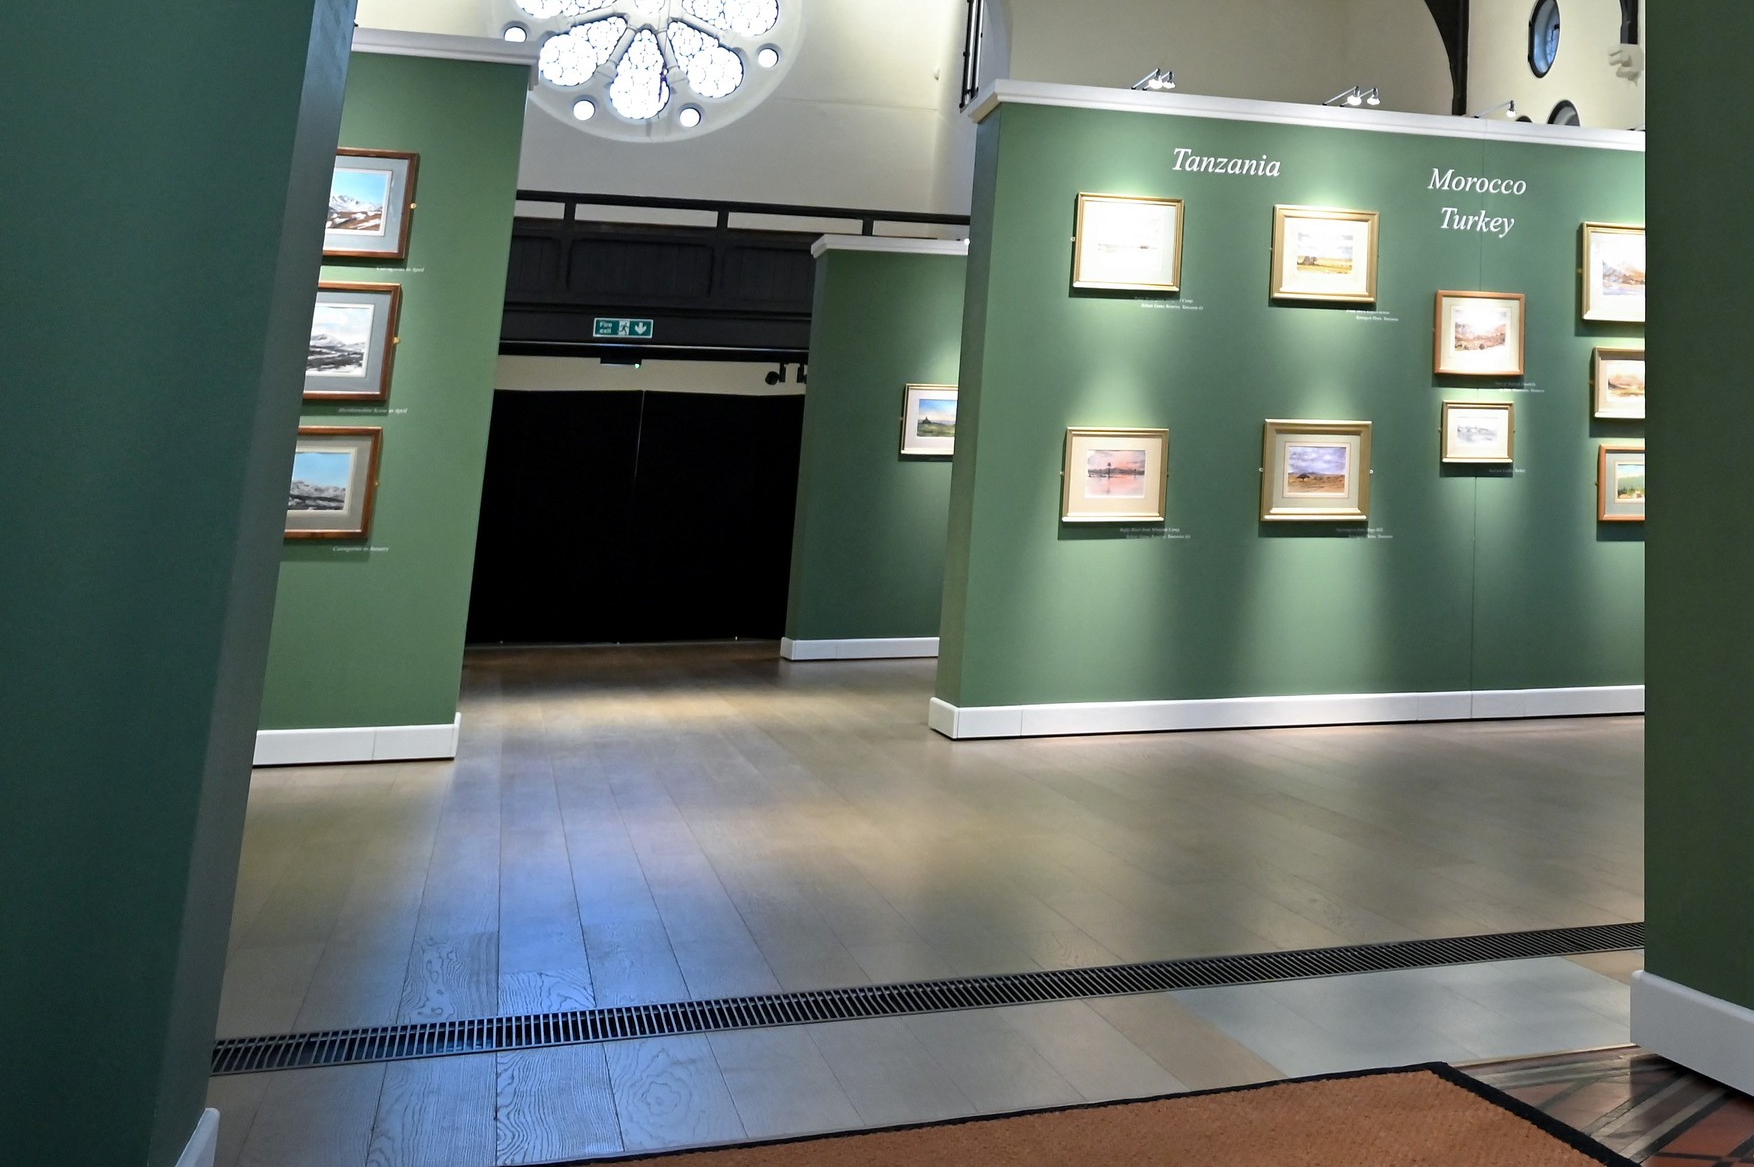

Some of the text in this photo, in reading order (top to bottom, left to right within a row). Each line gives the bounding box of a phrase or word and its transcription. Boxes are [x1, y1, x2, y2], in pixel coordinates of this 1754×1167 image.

[1172, 148, 1281, 177] Tanzania
[1427, 168, 1527, 195] Morocco
[1441, 207, 1515, 238] Turkey
